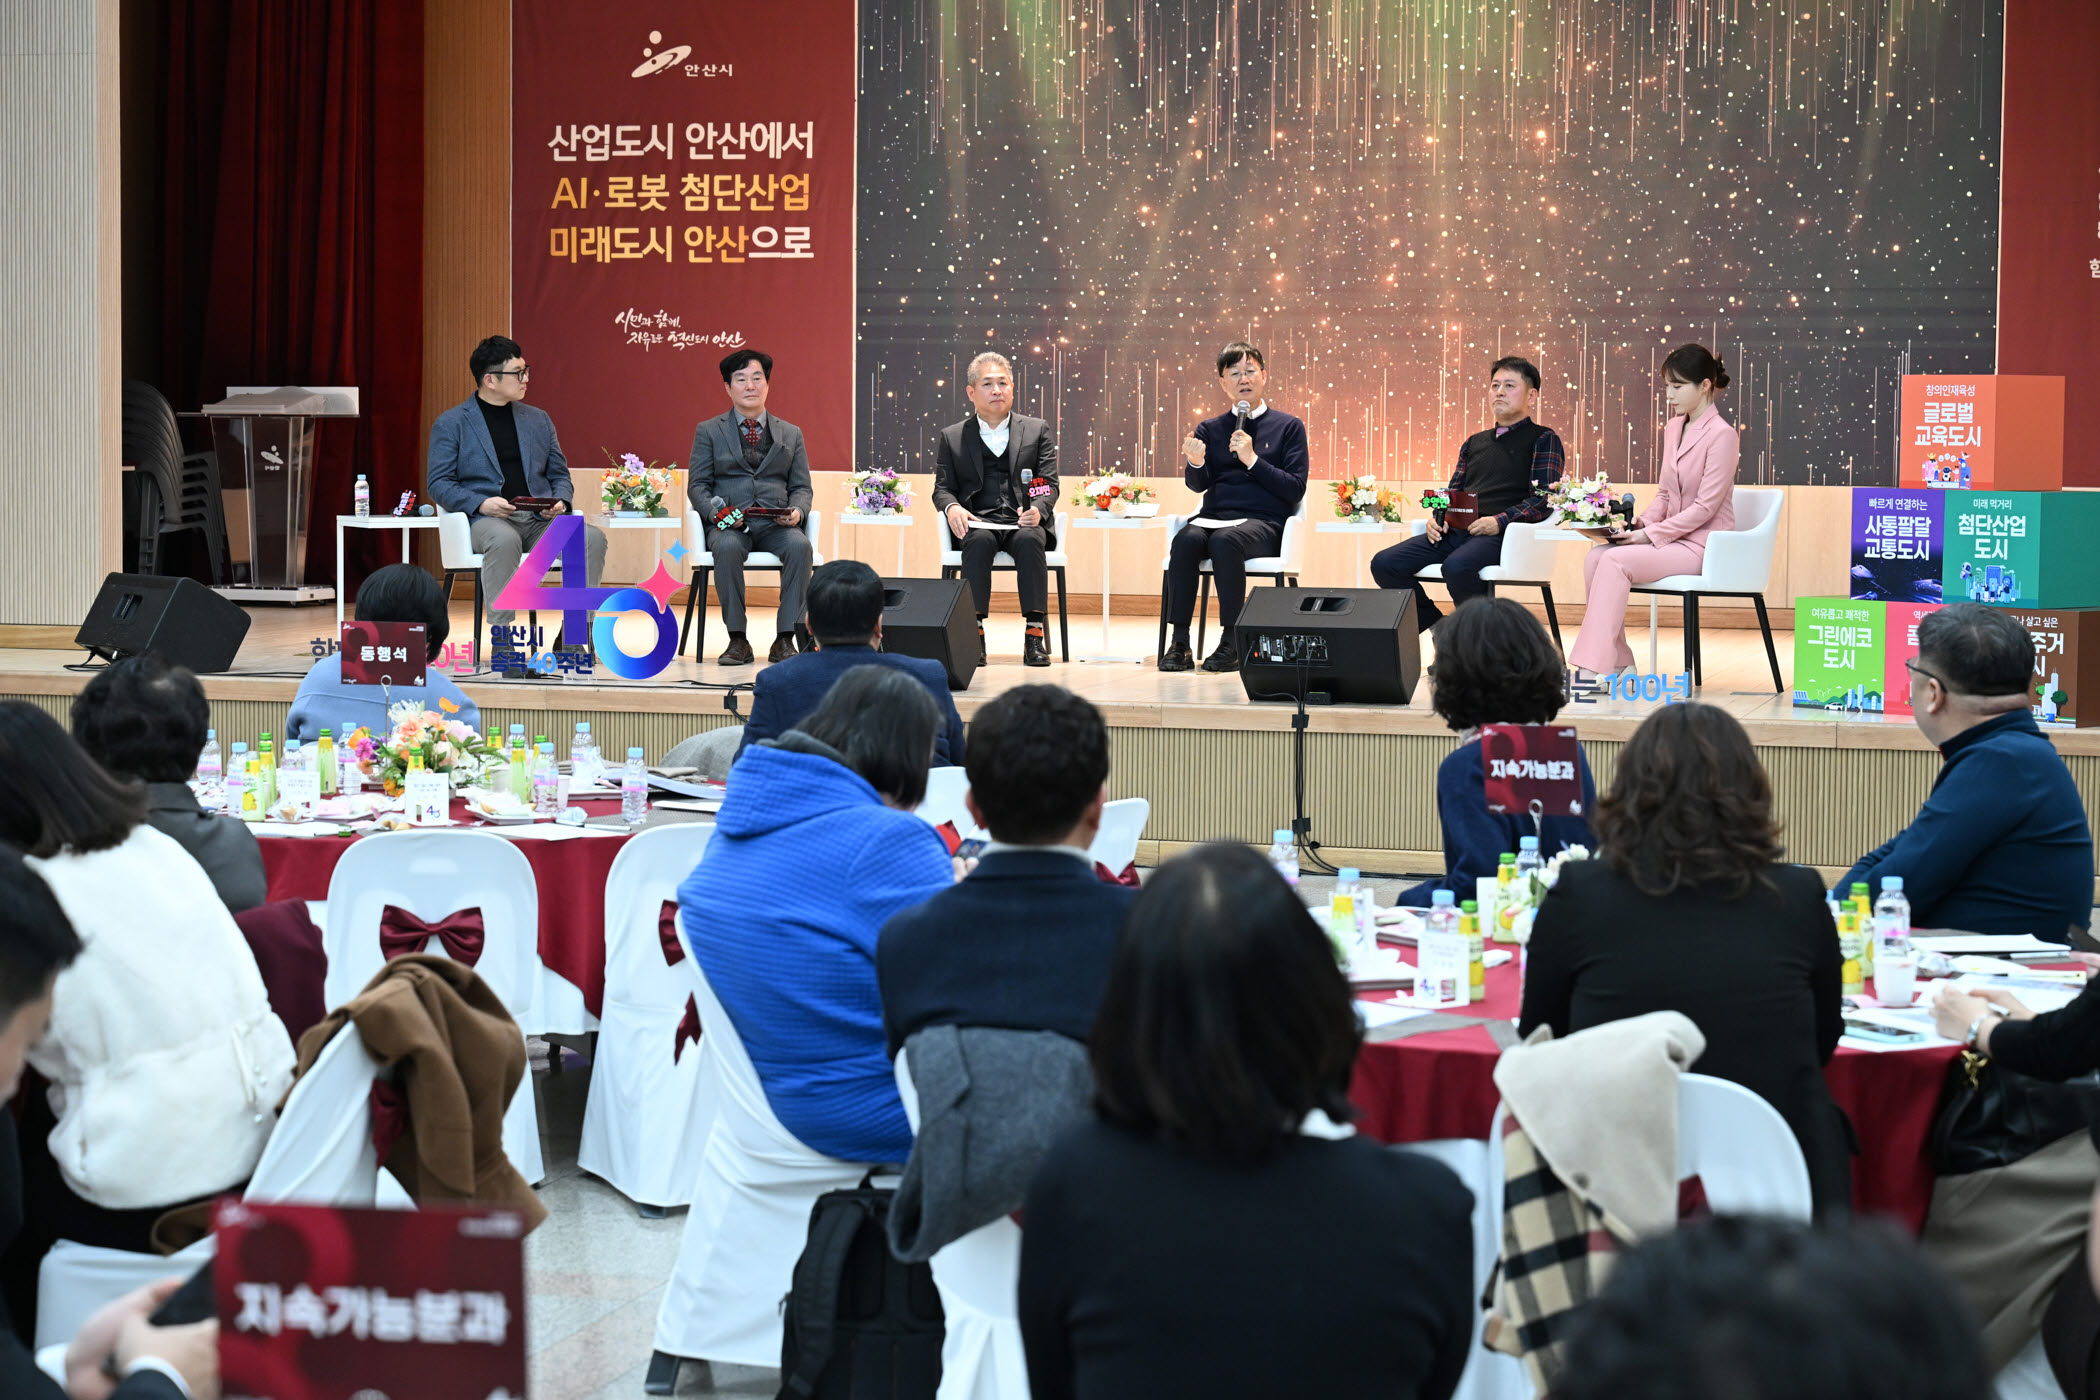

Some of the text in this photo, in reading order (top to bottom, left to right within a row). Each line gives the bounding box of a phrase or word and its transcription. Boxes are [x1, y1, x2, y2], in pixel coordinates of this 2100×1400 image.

[684, 63, 733, 77] 안산시
[548, 121, 814, 162] 산업도시 안산에서
[551, 173, 810, 212] AI·로봇 첨단산업
[550, 225, 814, 263] 미래도시 안산으로
[615, 307, 653, 333] 시민과
[626, 331, 746, 352] 자유로운 혁신도시 안산
[1926, 384, 1976, 397] 창의인재육성
[1923, 402, 1974, 423] 글로벌
[1914, 425, 1982, 447] 교육도시
[1868, 498, 1928, 511] 빠르게 연결하는
[1973, 498, 2012, 510] 미래 먹거리
[1865, 515, 1931, 537] 사통팔달
[1958, 513, 2026, 537] 첨단산업
[1864, 538, 1930, 561] 교통도시
[1974, 538, 2008, 560] 도시
[1811, 607, 1870, 622] 여유롭고 쾌적한
[2026, 616, 2041, 627] 살고
[2043, 617, 2058, 628] 싶은
[490, 625, 543, 647] 안산시
[1808, 625, 1872, 648] 그린에코
[2030, 632, 2064, 654] 주거
[360, 645, 408, 662] 동행석
[490, 651, 593, 674] 승격40주년
[1823, 648, 1855, 670] 도시
[2033, 655, 2046, 677] 시
[1604, 671, 1689, 706] 100년
[1490, 759, 1575, 780] 지속가능분과
[234, 1282, 511, 1344] 지속가능분과
